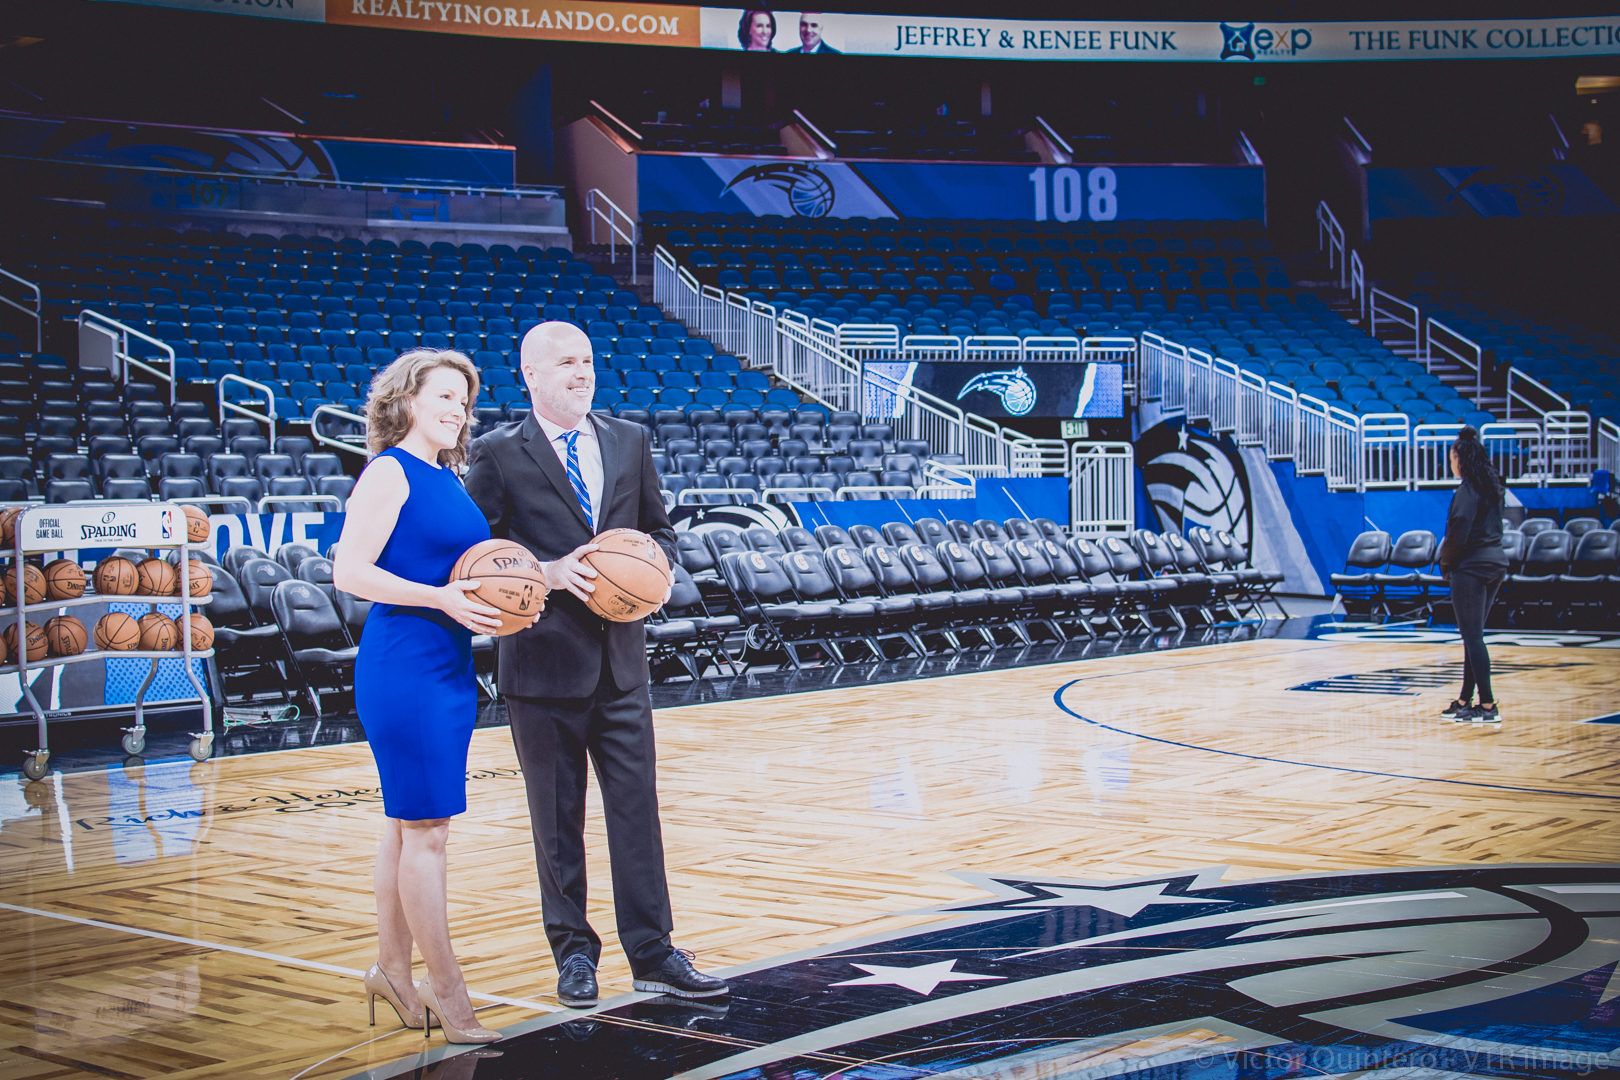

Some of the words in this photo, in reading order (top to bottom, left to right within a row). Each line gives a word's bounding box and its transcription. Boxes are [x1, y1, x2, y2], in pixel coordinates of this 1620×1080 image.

[351, 0, 679, 35] REALTYINORLANDO.COM
[894, 25, 991, 51] JEFFREY
[998, 30, 1015, 48] &
[1022, 30, 1102, 50] RENEE
[1109, 30, 1178, 50] FUNK
[1349, 30, 1401, 50] THE
[1408, 29, 1479, 50] FUNK
[1486, 25, 1620, 48] COLLECTI
[187, 183, 228, 205] 107
[1028, 166, 1118, 223] 108
[1066, 421, 1085, 436] EXIT
[36, 529, 50, 539] GAME
[51, 528, 64, 538] BALL
[39, 518, 60, 528] OFFICIAL
[81, 523, 136, 540] SPALDING
[203, 512, 325, 562] OVE
[493, 557, 542, 574] SPALDIN
